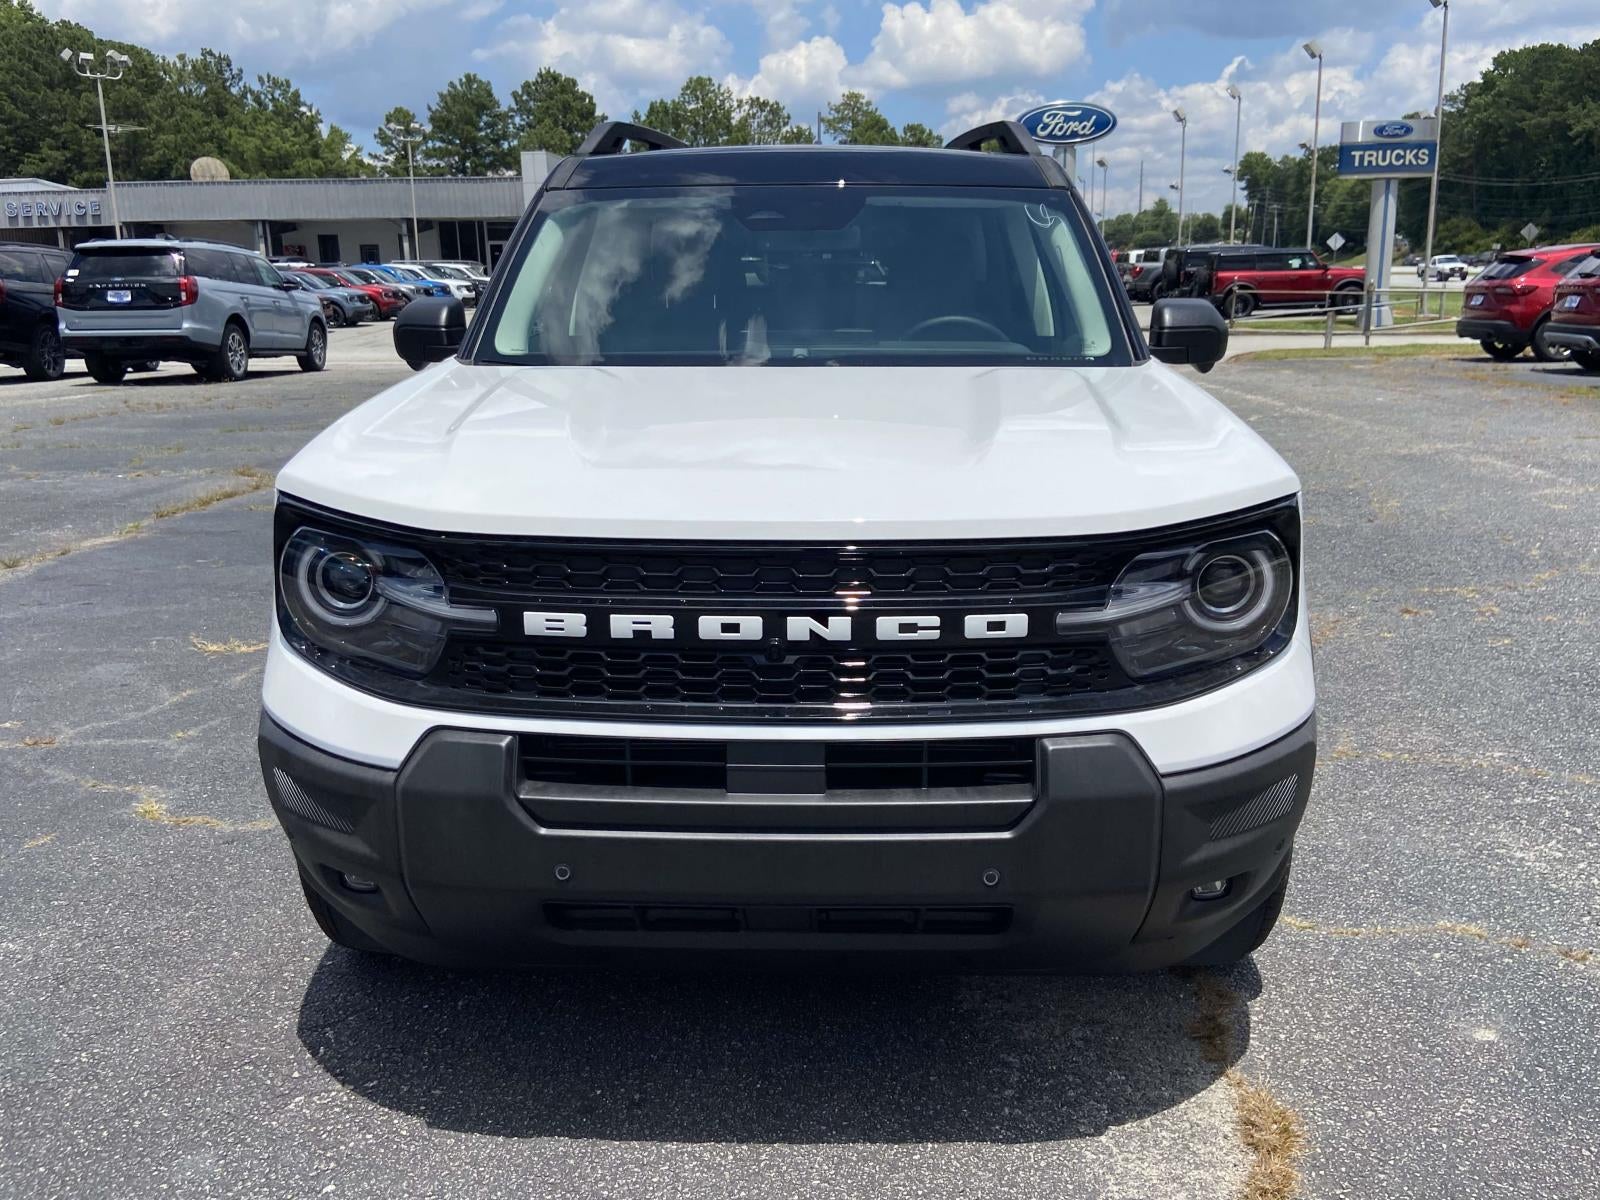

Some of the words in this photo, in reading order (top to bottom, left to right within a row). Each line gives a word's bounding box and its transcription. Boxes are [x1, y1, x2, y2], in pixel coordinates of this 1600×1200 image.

[1036, 110, 1096, 137] Ford
[1382, 125, 1406, 136] Ford
[1351, 148, 1430, 167] TRUCKS
[5, 200, 102, 217] SERVICE
[522, 610, 1029, 642] BRONCO
